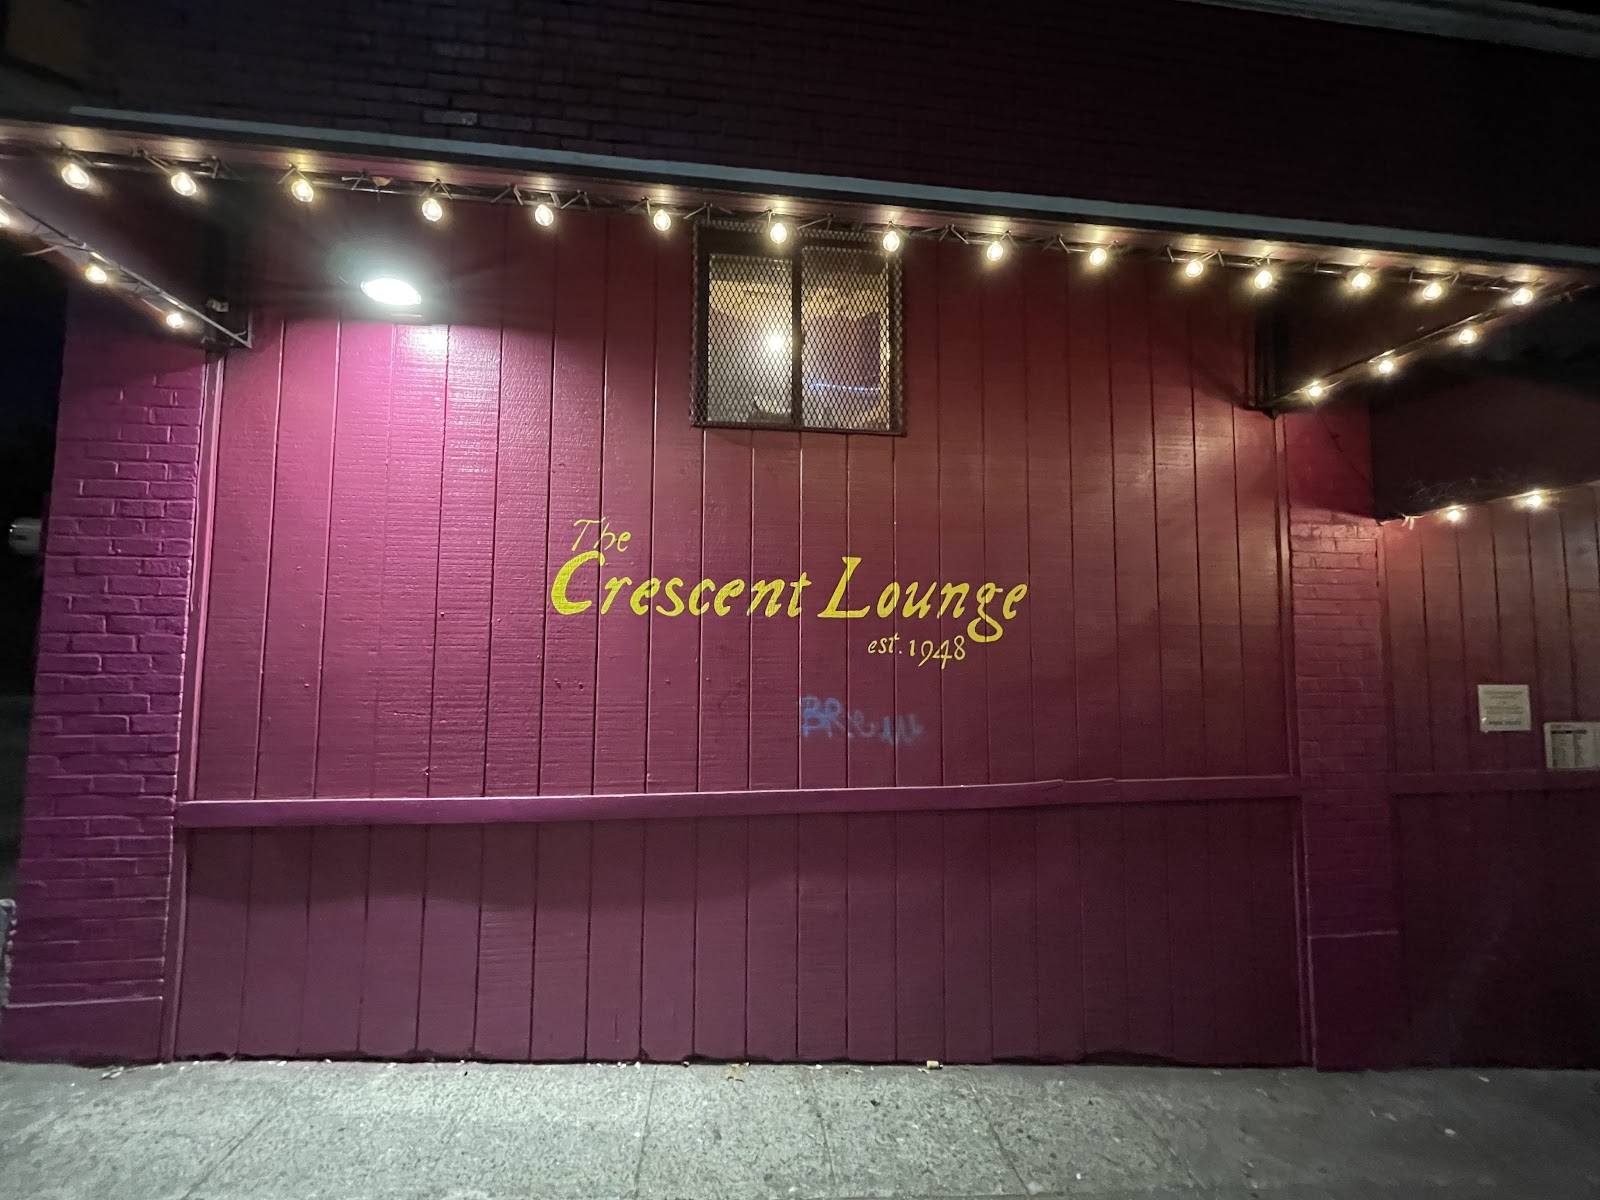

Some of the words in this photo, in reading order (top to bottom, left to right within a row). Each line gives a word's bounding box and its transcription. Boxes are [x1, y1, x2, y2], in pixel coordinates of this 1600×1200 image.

[571, 516, 632, 552] The
[550, 550, 812, 618] Crescent
[818, 556, 1029, 643] Lounge
[867, 632, 903, 655] est.
[909, 635, 966, 670] 1948
